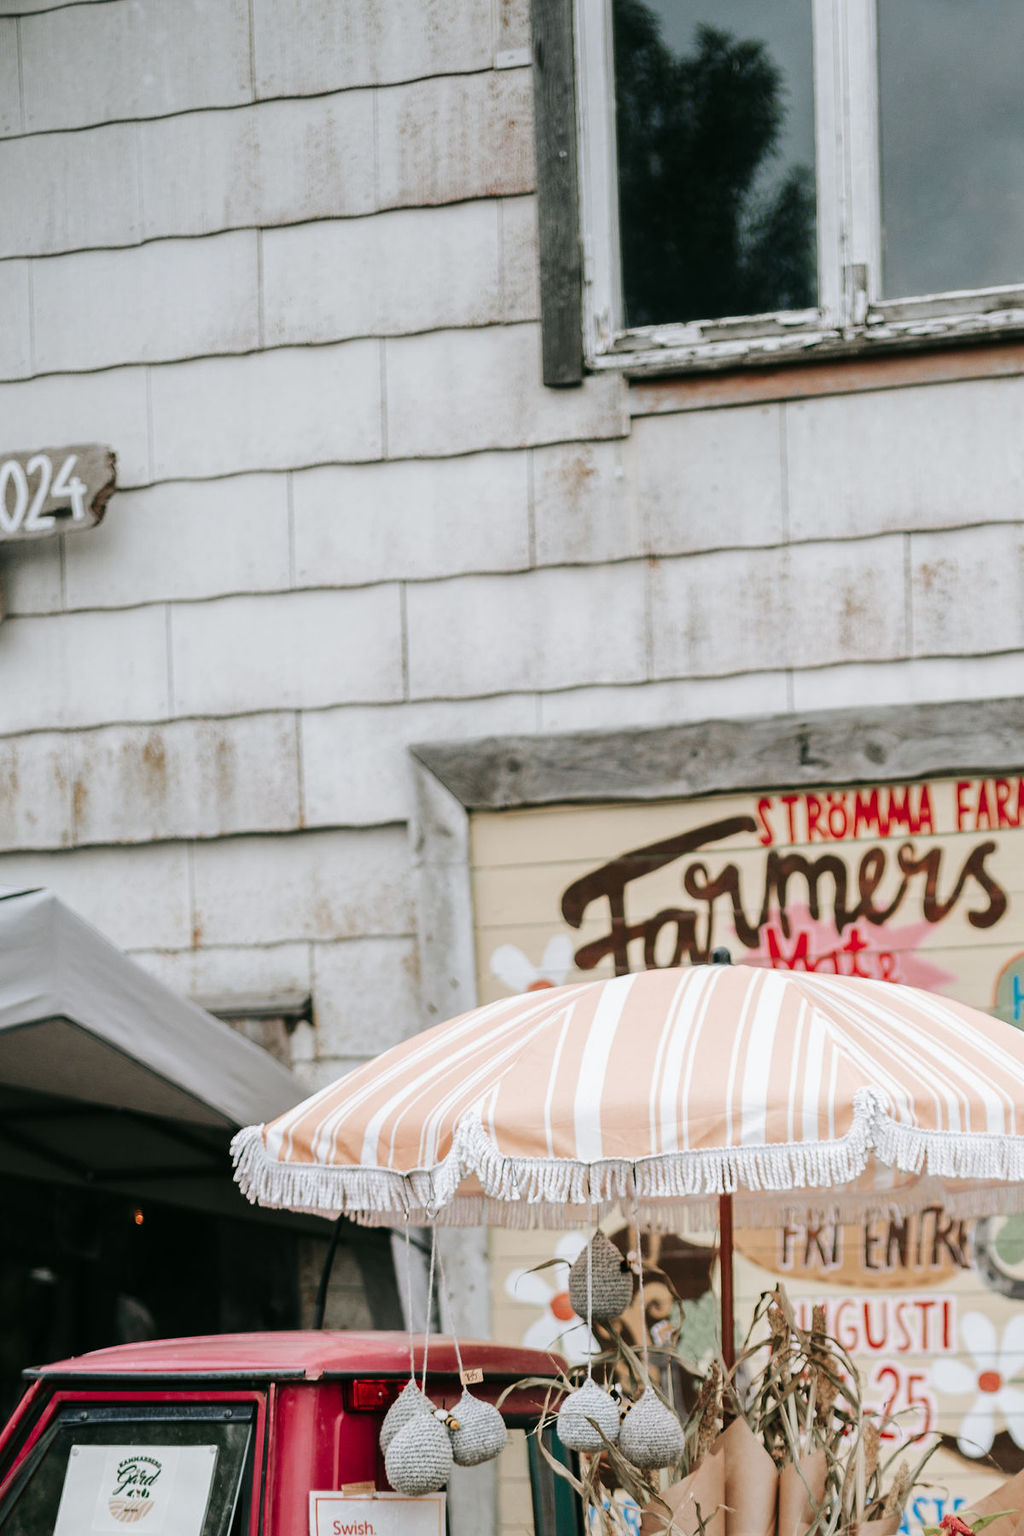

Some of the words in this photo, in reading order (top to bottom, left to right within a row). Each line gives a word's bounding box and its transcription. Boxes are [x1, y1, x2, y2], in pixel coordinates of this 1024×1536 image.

[756, 784, 934, 846] STRÖMMA
[561, 815, 1008, 974] Farmers
[782, 1206, 838, 1267] FRI
[112, 1464, 162, 1496] Gård
